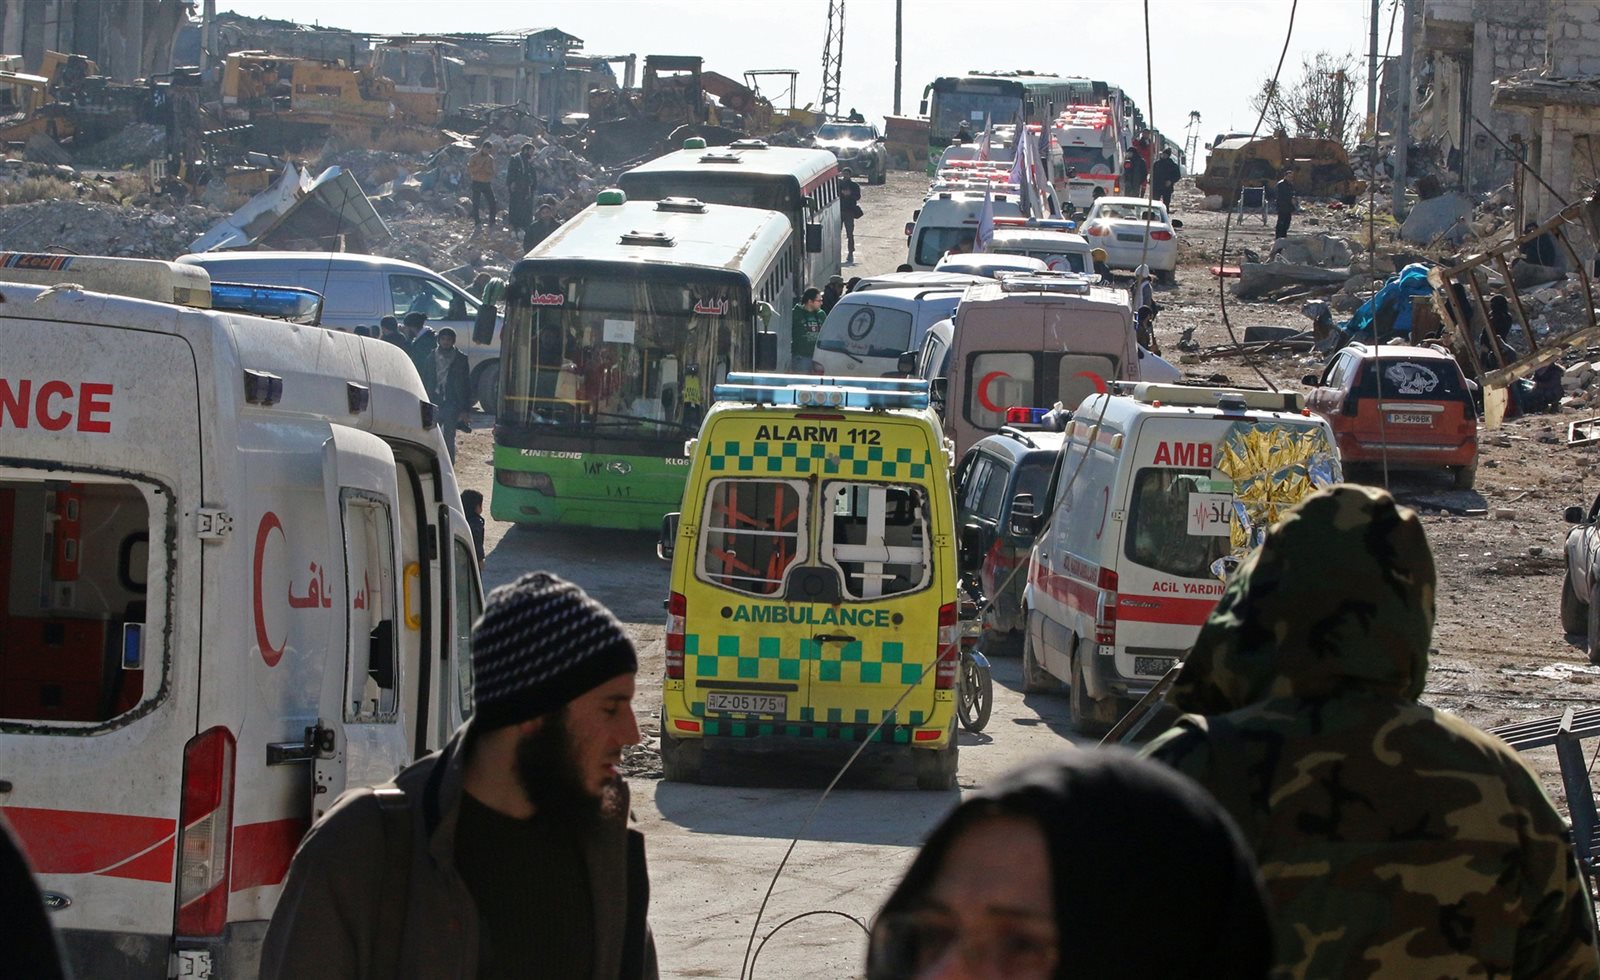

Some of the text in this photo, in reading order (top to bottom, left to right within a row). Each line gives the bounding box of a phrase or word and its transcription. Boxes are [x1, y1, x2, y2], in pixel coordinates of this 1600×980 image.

[755, 425, 881, 445] ALARM 112
[521, 448, 582, 460] KING LONG
[733, 605, 890, 627] AMBULANCE
